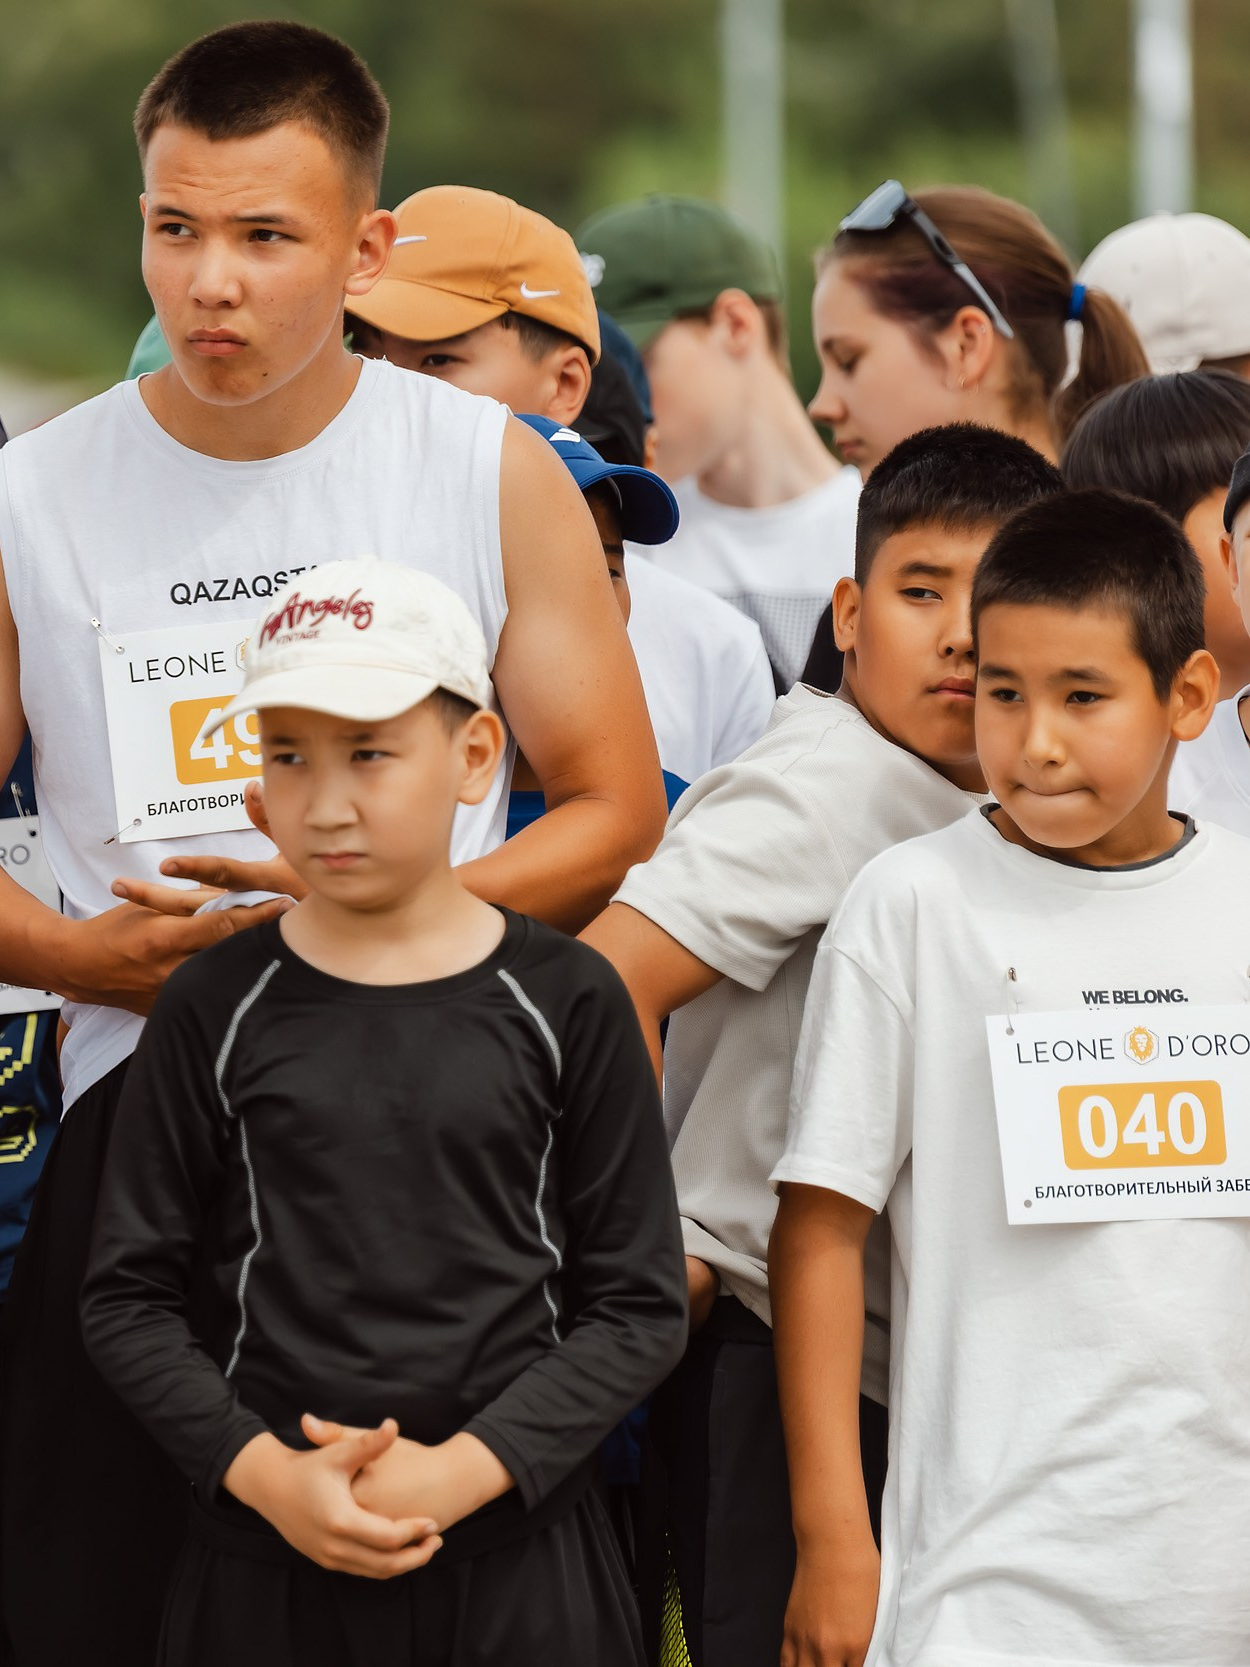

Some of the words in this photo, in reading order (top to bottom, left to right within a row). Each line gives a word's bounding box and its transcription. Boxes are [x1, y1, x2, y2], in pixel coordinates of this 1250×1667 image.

[170, 565, 317, 605] QAZAQS
[129, 651, 227, 683] LEONE
[1082, 990, 1110, 1004] WE
[1113, 989, 1188, 1004] BELONG.
[1017, 1038, 1114, 1064] LEONE
[1168, 1034, 1250, 1057] D'ORO
[1078, 1092, 1207, 1159] 040
[1035, 1177, 1211, 1199] БЛАГОТВОРИТЕЛЬНЫЙ
